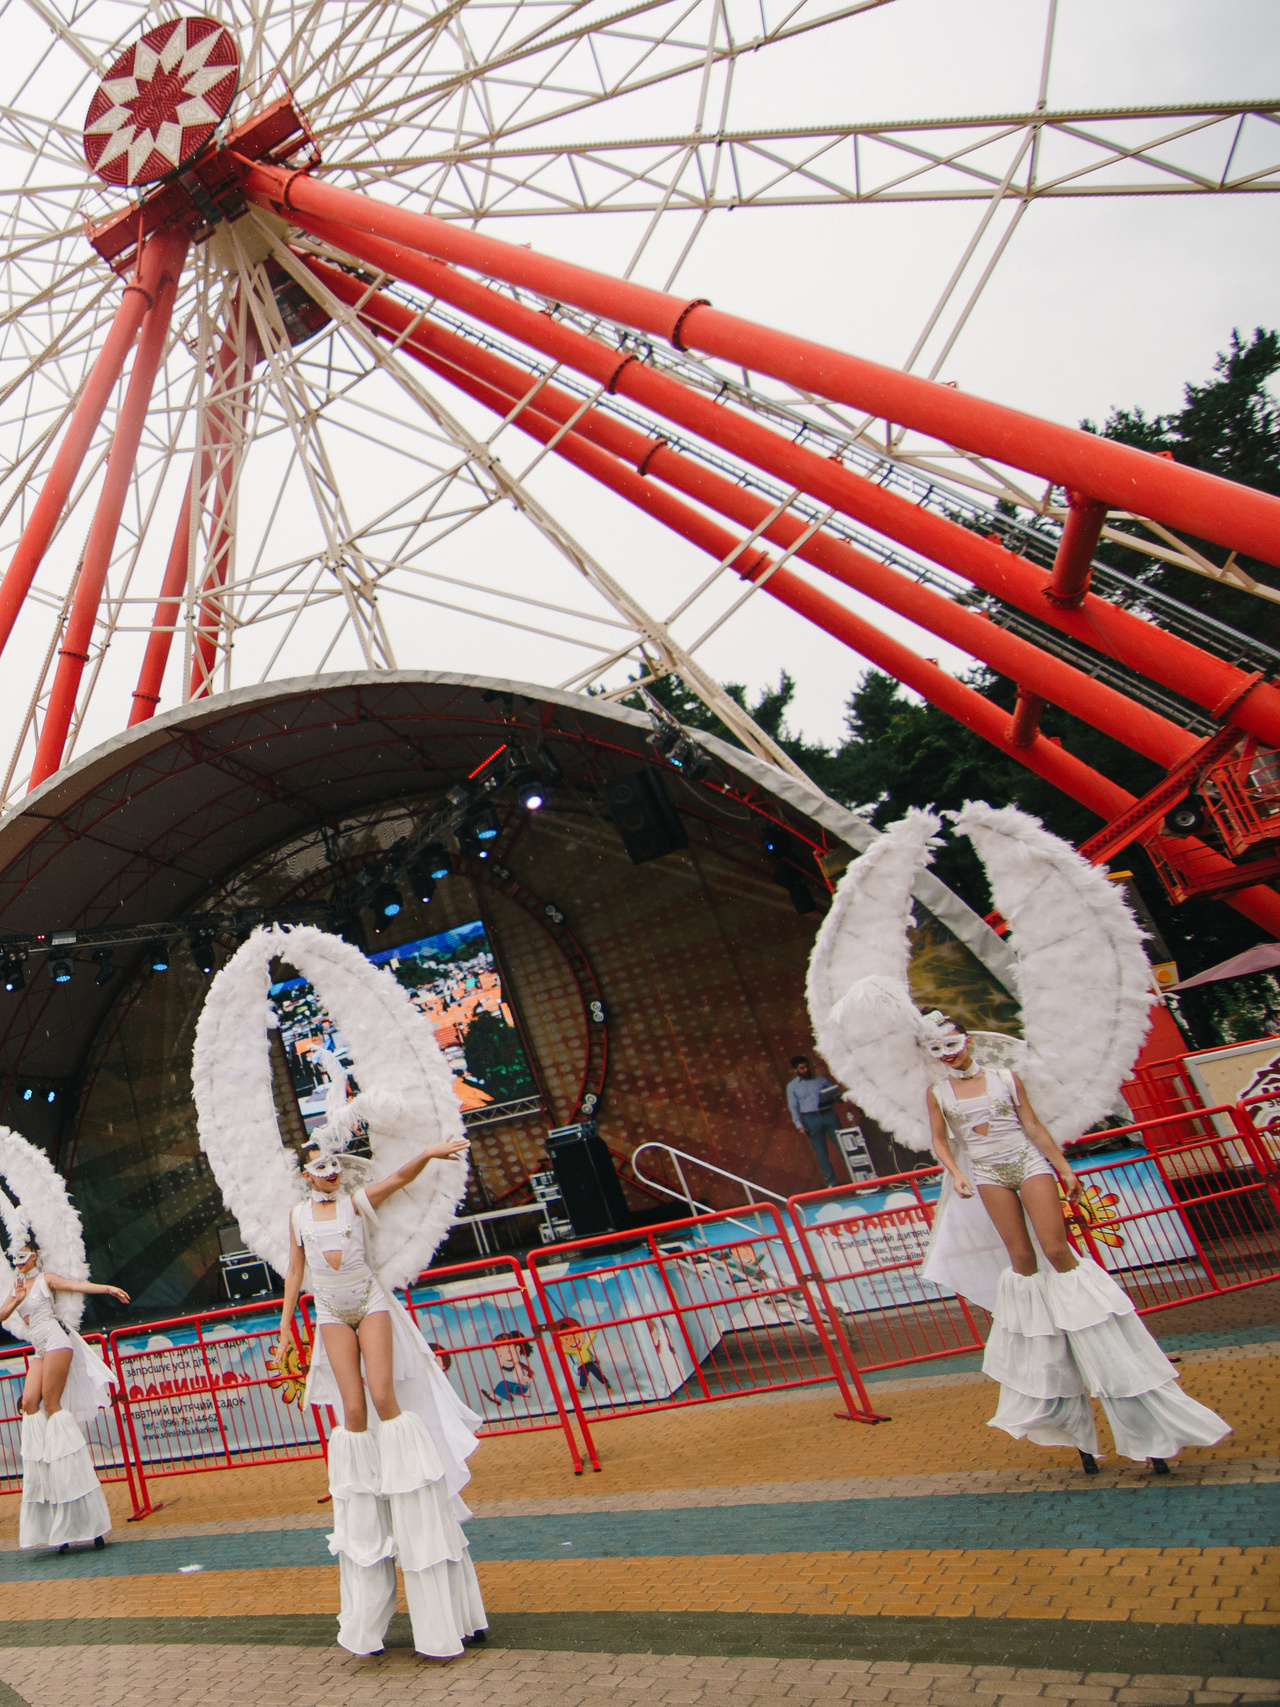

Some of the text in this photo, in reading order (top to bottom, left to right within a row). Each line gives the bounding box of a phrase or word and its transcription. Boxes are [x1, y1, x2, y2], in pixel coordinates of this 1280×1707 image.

[897, 1229, 930, 1243] дитяч
[177, 1344, 217, 1357] диячий
[126, 1363, 172, 1378] запрошує
[172, 1360, 192, 1373] усх
[107, 1371, 252, 1404] ОЛНИШКО»
[121, 1396, 247, 1424] риватний дитячий садок
[141, 1425, 229, 1442] www.solnishko.kharkov.a
